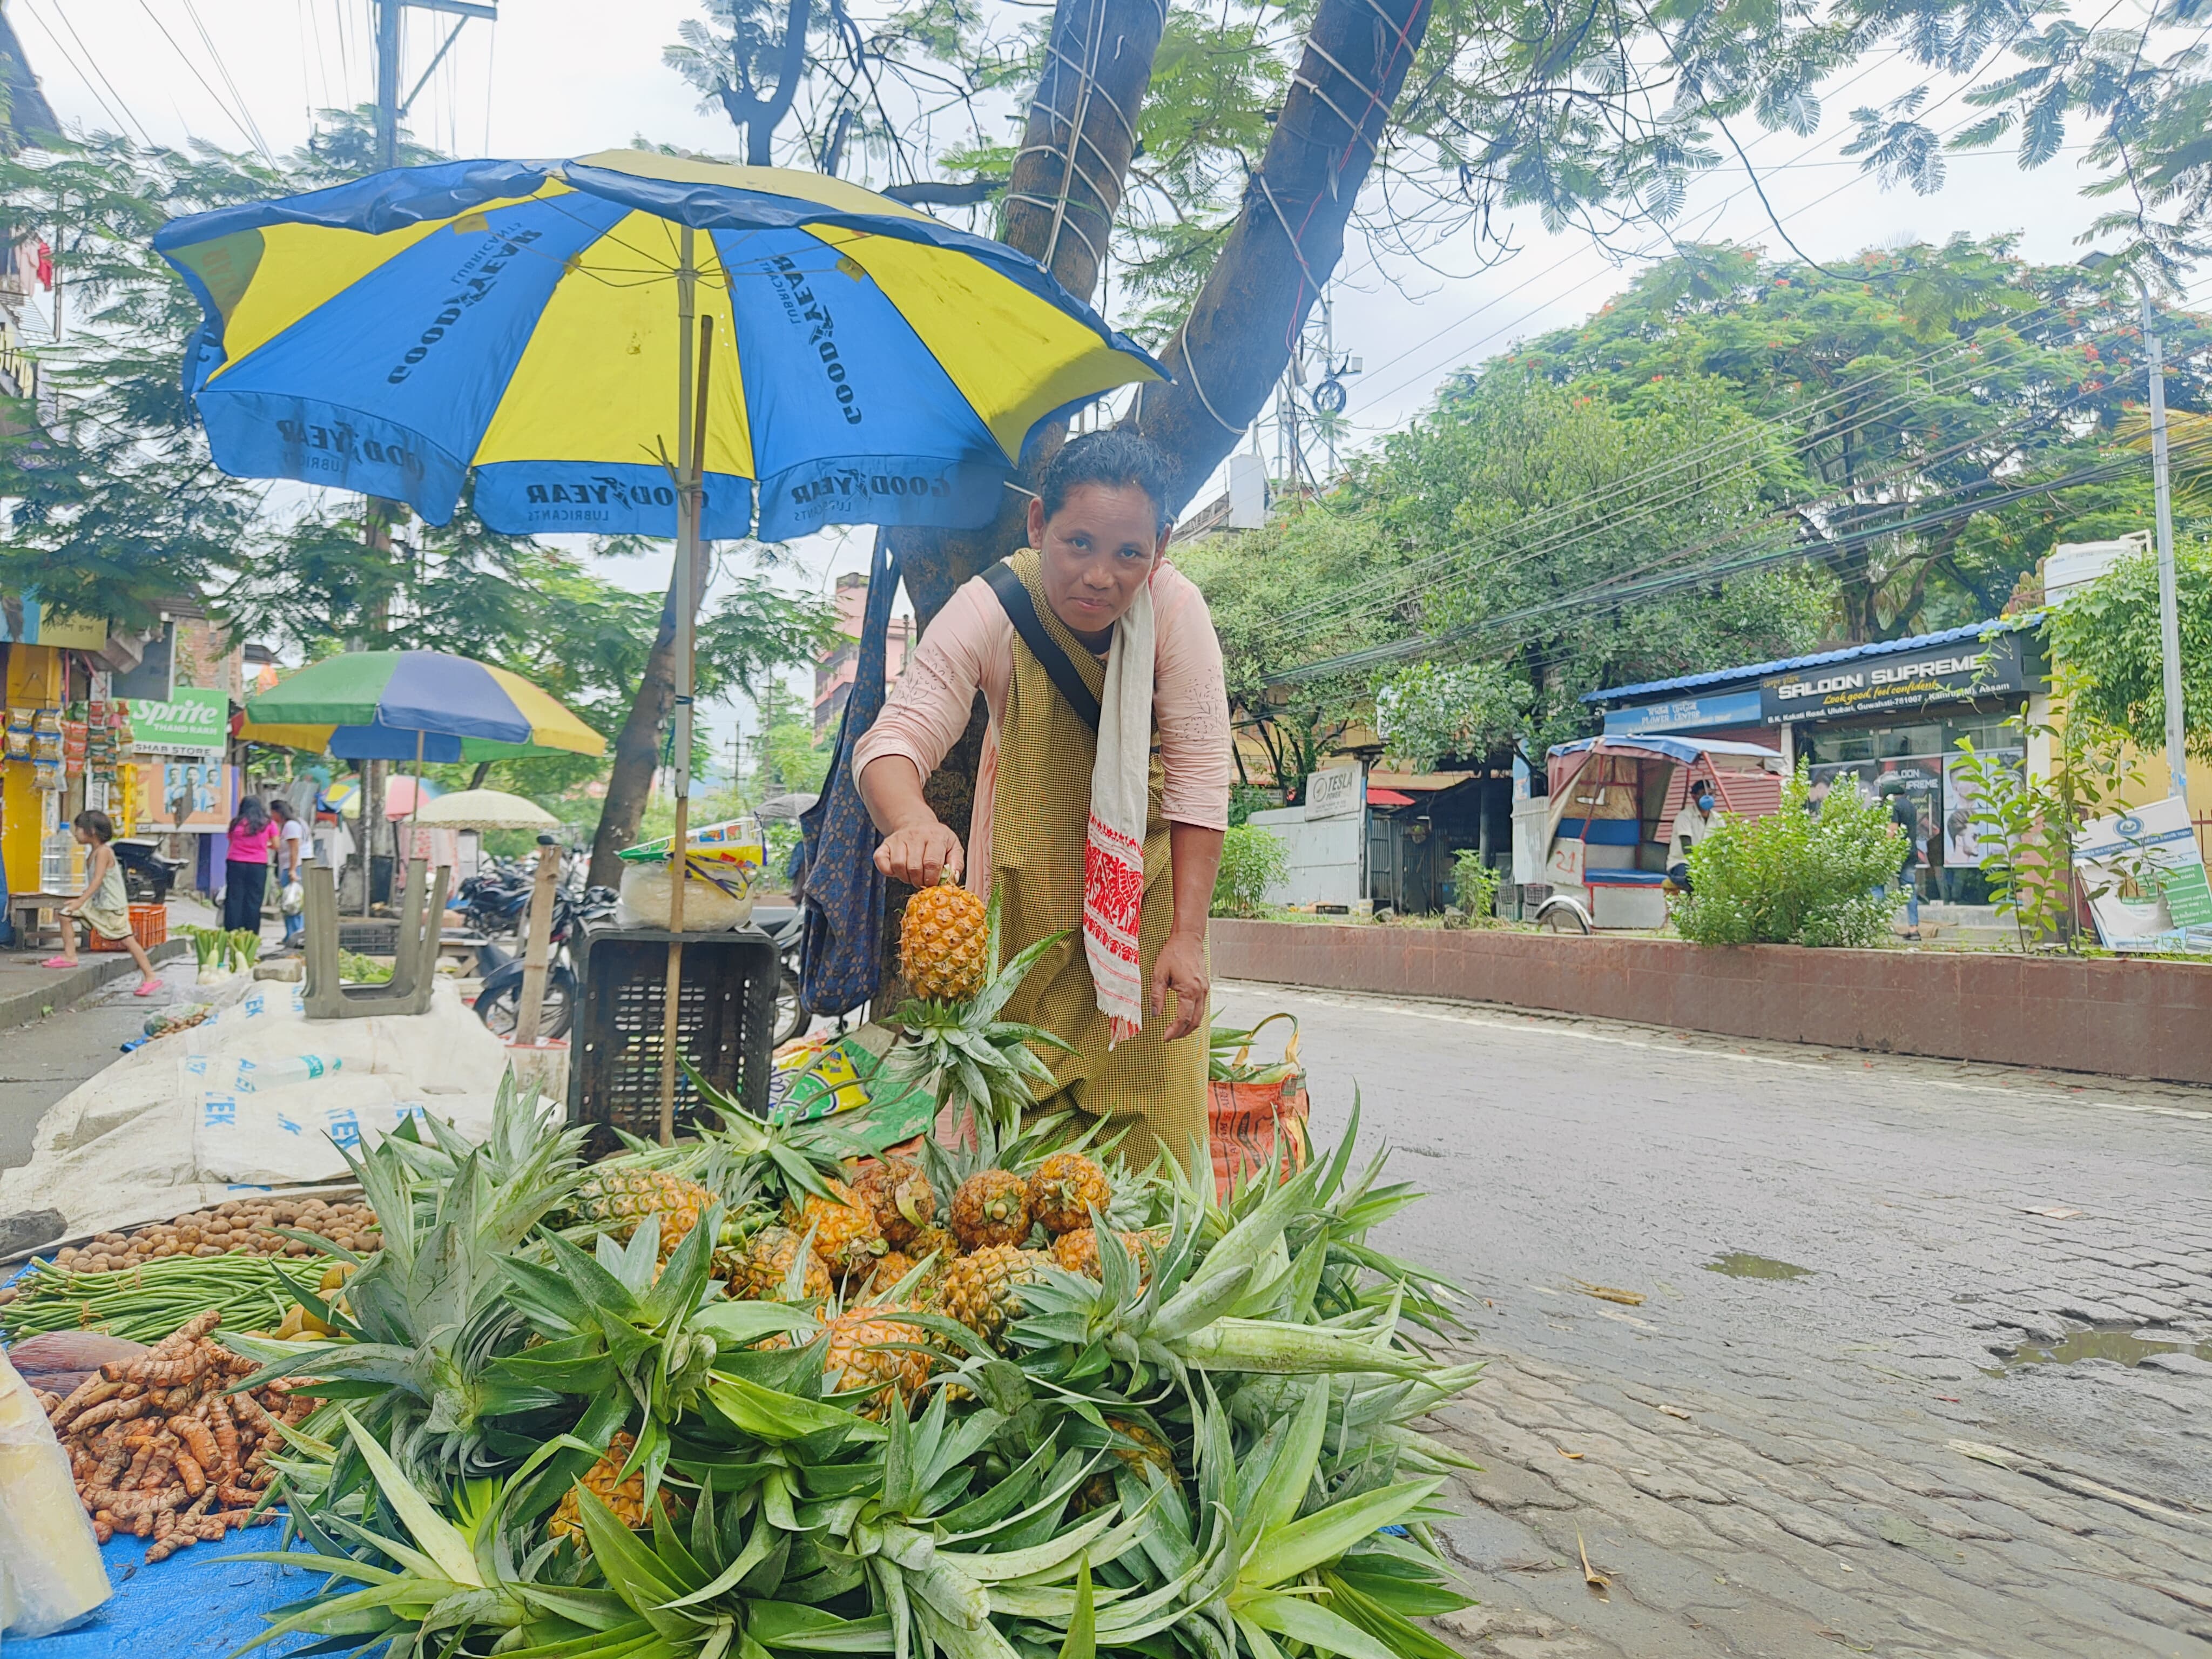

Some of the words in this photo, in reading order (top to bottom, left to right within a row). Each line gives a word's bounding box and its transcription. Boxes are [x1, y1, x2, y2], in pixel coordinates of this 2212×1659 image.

[1778, 673, 1864, 699] SALOON
[1871, 654, 1987, 685] SUPREME
[1823, 692, 1846, 705] Look
[1873, 684, 1892, 700] feel
[1979, 683, 2010, 693] Assam
[132, 699, 218, 726] Sprite
[172, 746, 211, 756] STORE
[1328, 771, 1353, 793] TESLA
[1556, 851, 1576, 873] 21
